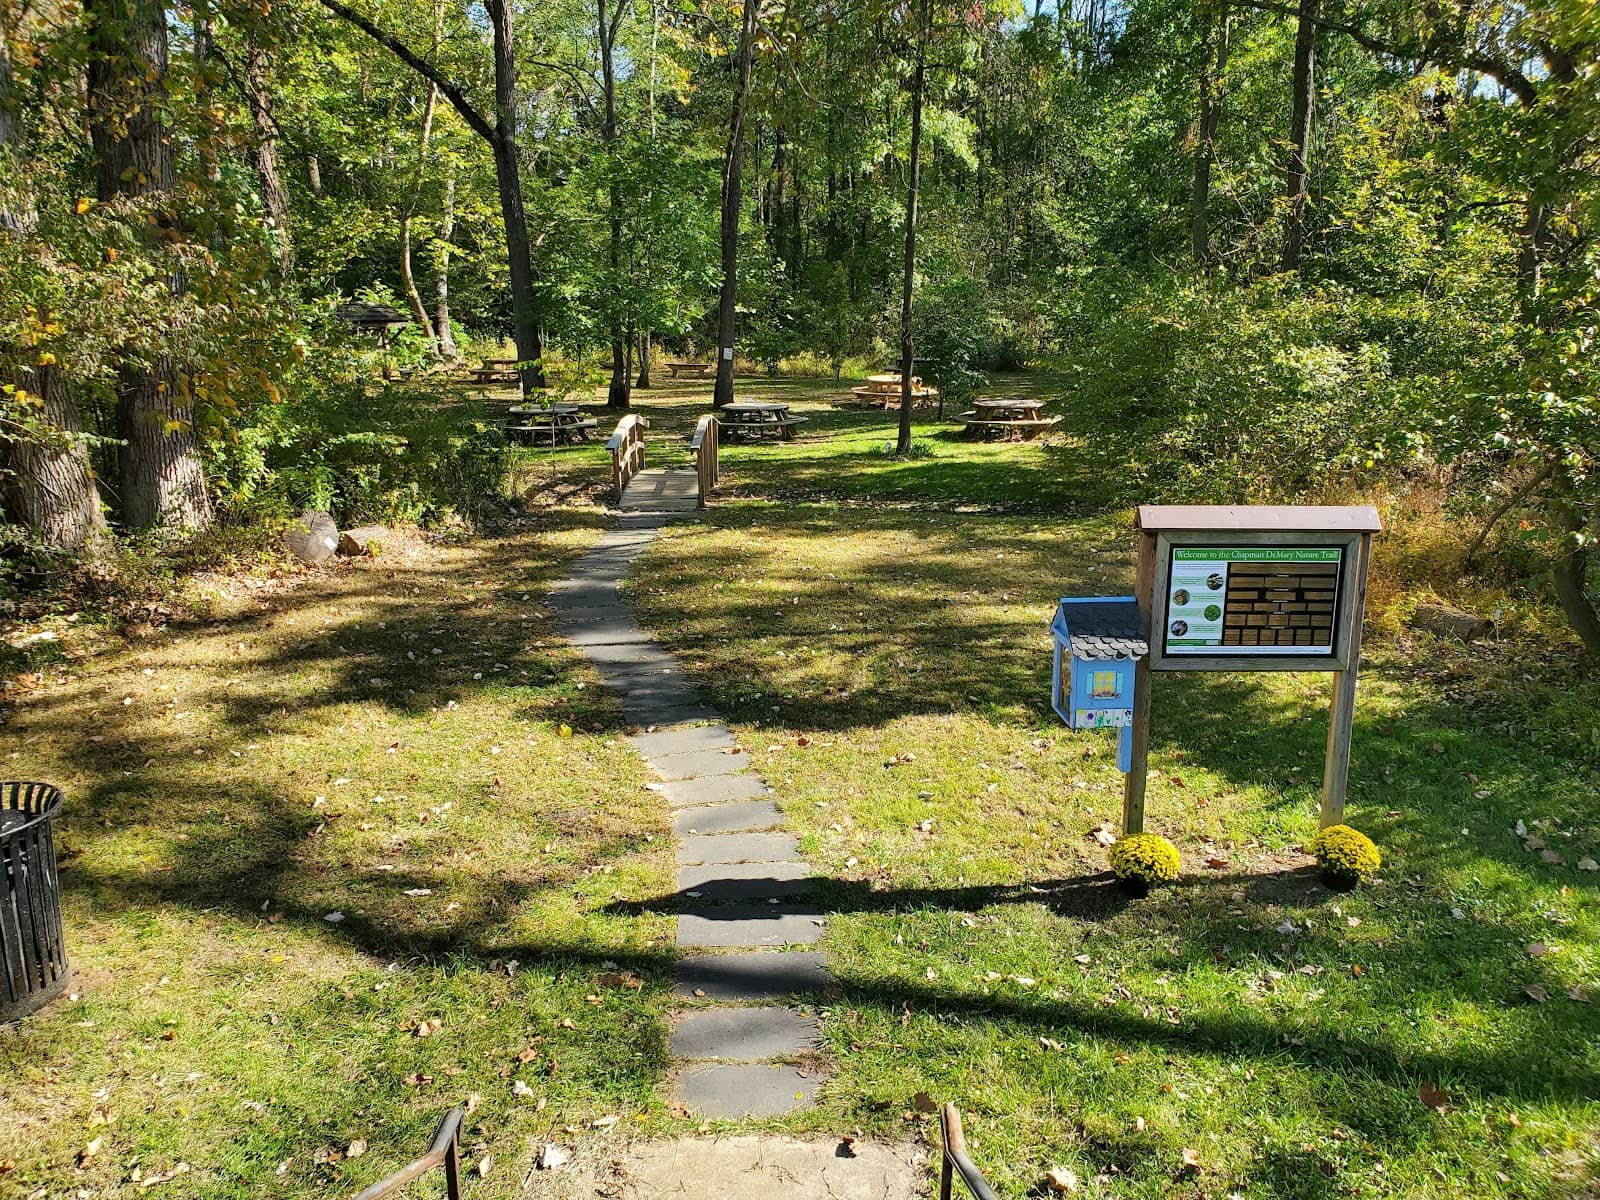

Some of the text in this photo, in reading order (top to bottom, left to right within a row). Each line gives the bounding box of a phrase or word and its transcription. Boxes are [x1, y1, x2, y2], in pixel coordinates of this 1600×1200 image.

[1231, 551, 1264, 560] Chapman
[1265, 551, 1294, 560] DeMary
[1295, 551, 1319, 559] Nature
[1321, 551, 1339, 559] Trail
